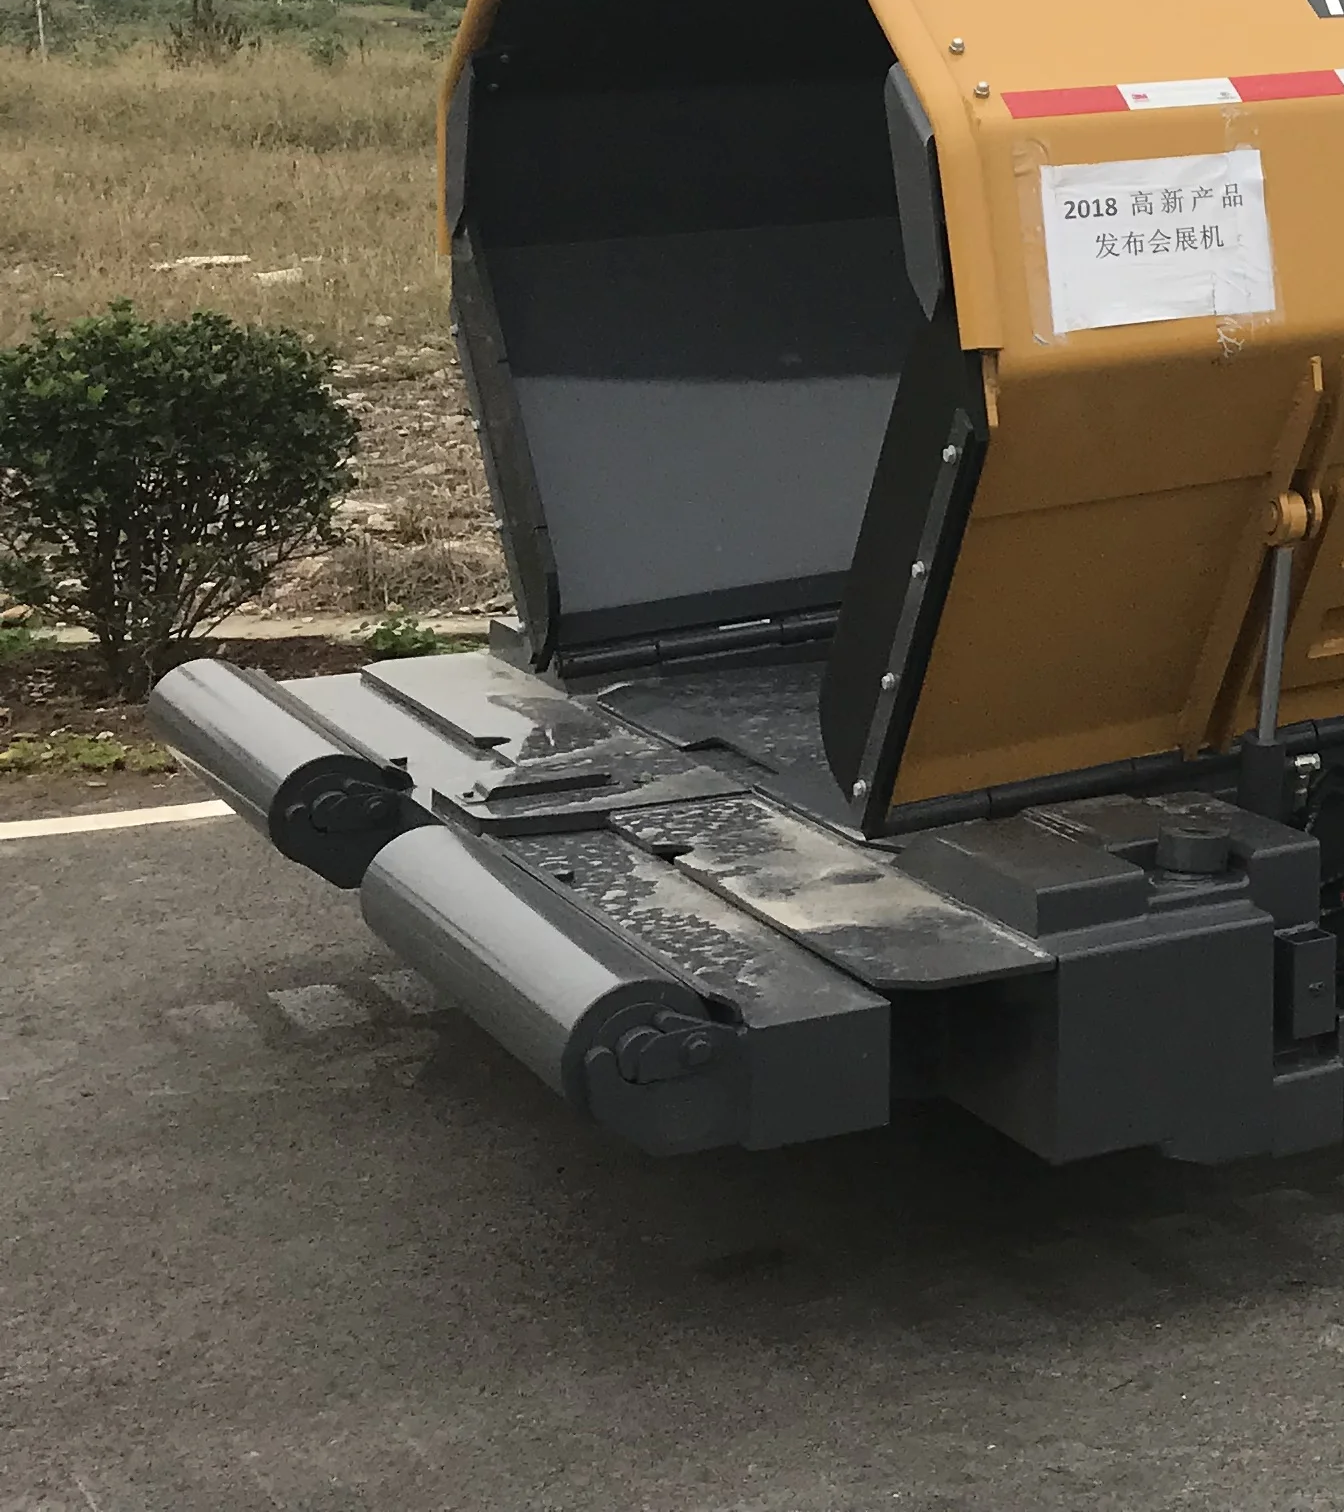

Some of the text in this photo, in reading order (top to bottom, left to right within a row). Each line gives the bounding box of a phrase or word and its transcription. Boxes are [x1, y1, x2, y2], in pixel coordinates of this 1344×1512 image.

[1064, 183, 1243, 219] 2018 高新产品
[1095, 225, 1224, 258] 发布会展机
